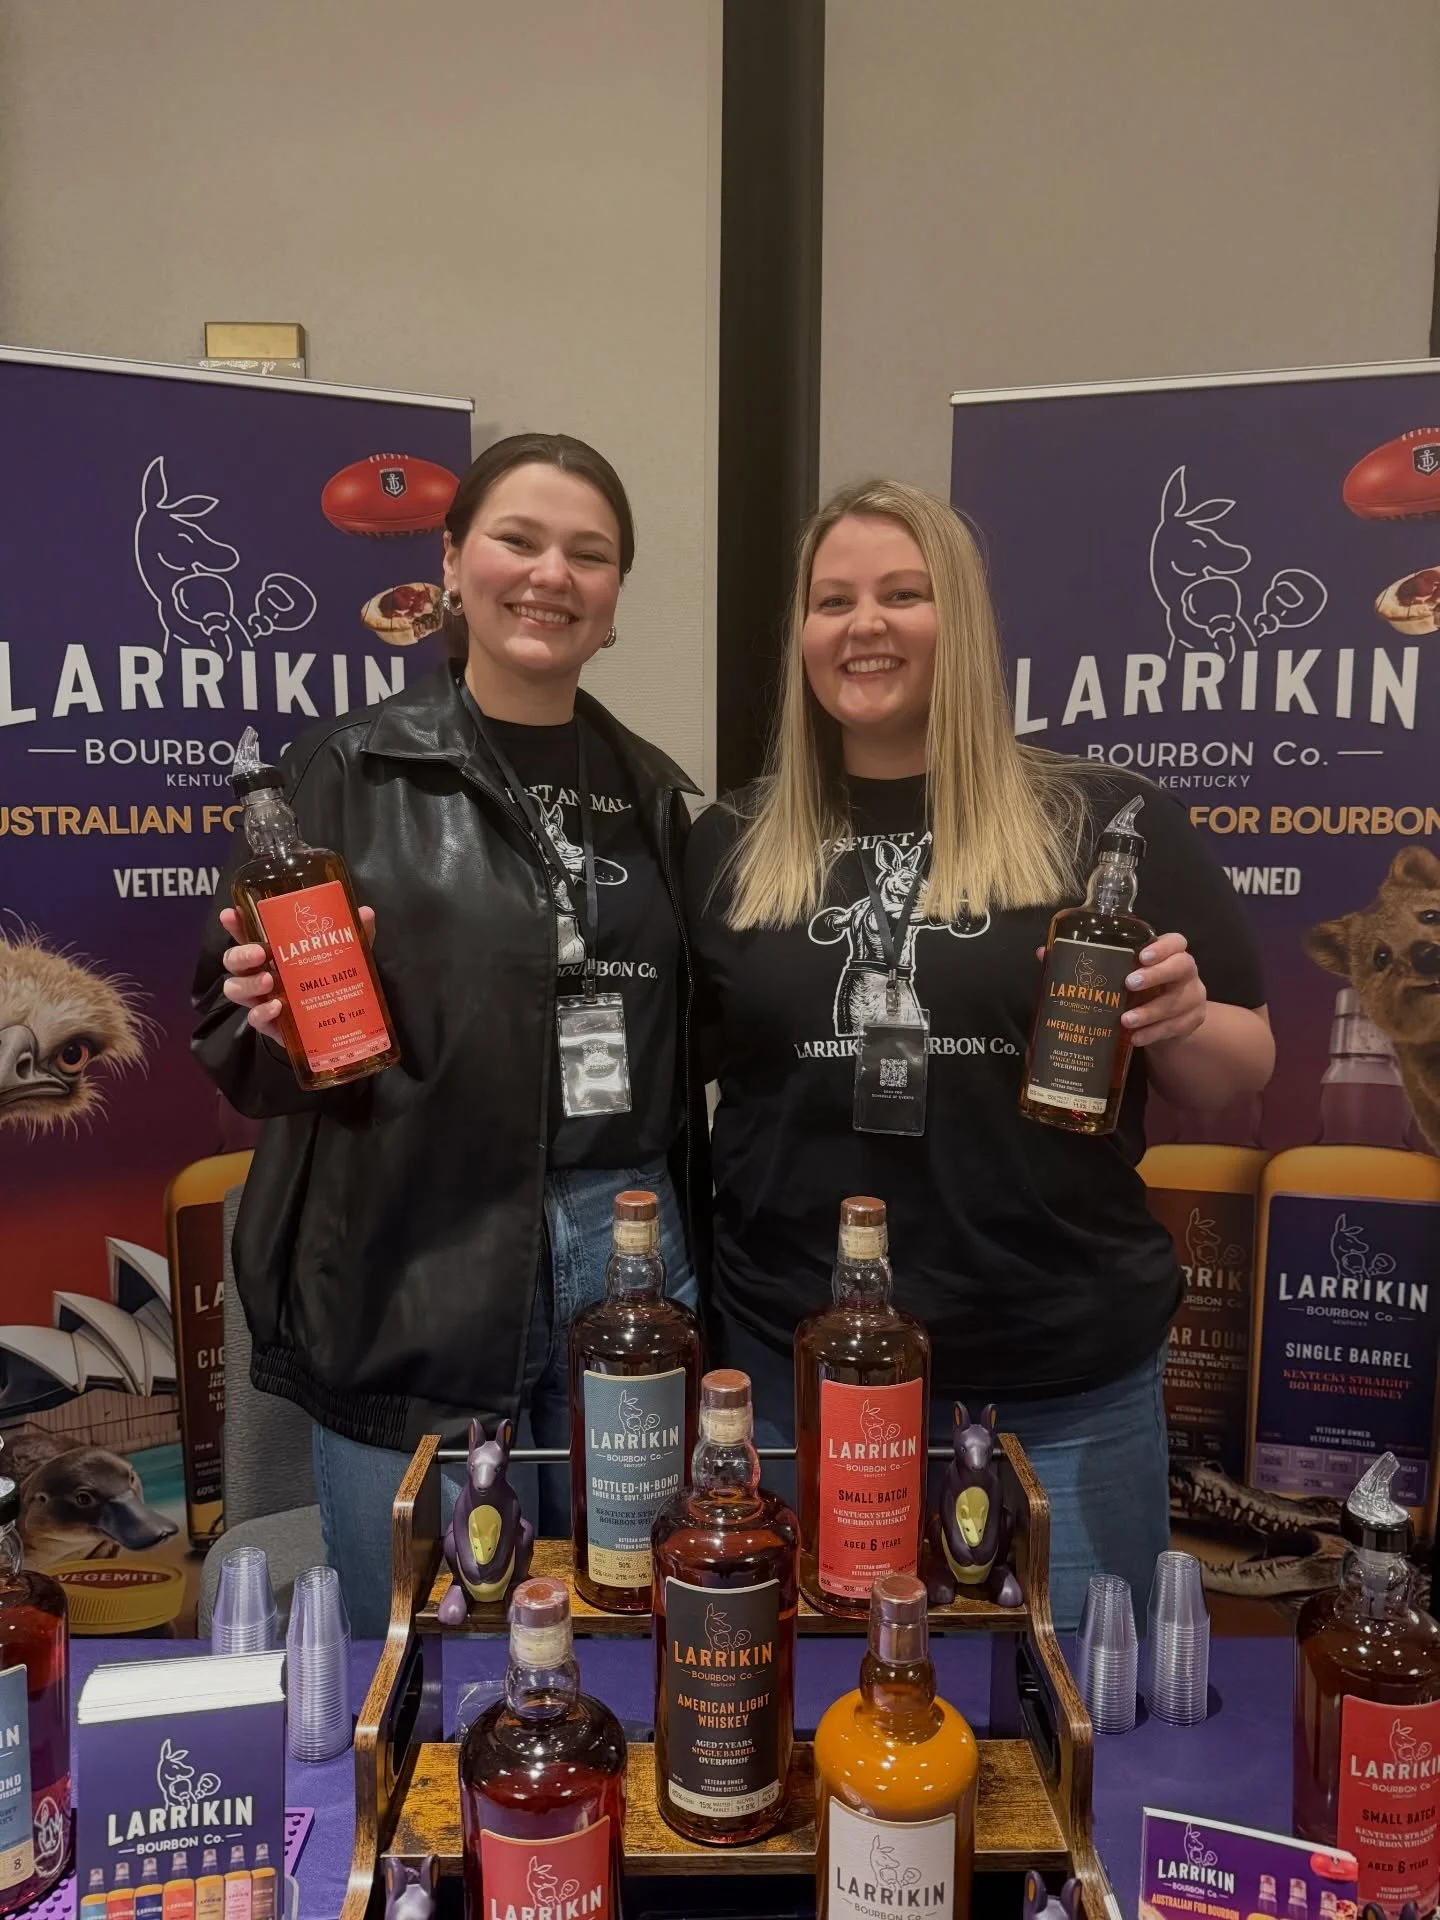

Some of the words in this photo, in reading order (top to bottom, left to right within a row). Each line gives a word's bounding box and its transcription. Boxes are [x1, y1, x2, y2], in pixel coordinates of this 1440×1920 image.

[0, 641, 406, 727] LARRIKIN
[1014, 646, 1420, 737] LARRIKIN
[1088, 741, 1254, 767] BOURBON
[1274, 741, 1329, 767] Co.
[166, 774, 233, 787] KENTUC
[1158, 775, 1251, 788] KENTUCKY
[0, 806, 193, 835] STRALIAN
[202, 806, 245, 834] FO
[1222, 866, 1301, 896] WNED
[277, 926, 355, 963] LARRIKIN
[300, 976, 331, 992] SMALL
[332, 967, 358, 984] BATCH
[1050, 981, 1121, 1009] LARRIKIN
[318, 1017, 337, 1028] AGED
[338, 1012, 346, 1024] 6
[348, 1008, 366, 1019] YEARS
[1045, 1018, 1087, 1034] AMERICAN
[1088, 1024, 1113, 1038] LIGHT
[794, 1040, 860, 1058] LARRIK
[989, 1037, 1020, 1056] Co.
[1058, 1031, 1095, 1046] WHISKEY
[1279, 1272, 1429, 1312] LARRIKIN
[1306, 1305, 1370, 1321] BOURBON
[1285, 1342, 1343, 1362] SINGLE
[1349, 1347, 1412, 1369] BARREL
[1283, 1369, 1346, 1383] KENTUCKY
[1348, 1375, 1411, 1390] STRAIGHT
[1288, 1381, 1347, 1395] BOURBON
[1347, 1386, 1404, 1400] WHISKEY
[590, 1425, 680, 1450] LARRIKIN
[1316, 1426, 1346, 1436] VETERAN
[828, 1436, 917, 1460] LARRIKIN
[1309, 1435, 1340, 1445] VETERAN
[1341, 1438, 1376, 1449] DISTILLED
[606, 1453, 647, 1463] BOURBON
[846, 1463, 887, 1473] BOURBON
[591, 1474, 679, 1494] BOTTLED-IN-BOND
[643, 1486, 678, 1501] SUPERVISION
[838, 1489, 874, 1504] SMALL
[877, 1487, 908, 1503] BATCH
[595, 1507, 636, 1519] KENTUCKY
[833, 1507, 876, 1519] KENTUCKY
[876, 1505, 911, 1518] STRAIGHT
[837, 1516, 876, 1526] BOURBON
[876, 1514, 907, 1526] WHISKEY
[843, 1540, 866, 1550] AGED
[870, 1538, 878, 1551] 6
[881, 1538, 901, 1549] YEARS
[58, 1572, 165, 1582] VEGEMITE
[674, 1640, 773, 1667] LARRIKIN
[691, 1670, 736, 1682] BOURBON
[677, 1693, 735, 1714] AMERICAN
[739, 1692, 770, 1713] LIGHT
[698, 1714, 749, 1729] WHISKEY
[691, 1746, 723, 1757] SINGLE
[723, 1746, 757, 1757] BARREL
[695, 1739, 718, 1749] AGED
[724, 1738, 753, 1749] YEARS
[698, 1756, 750, 1766] OVERPROOF
[700, 1784, 723, 1792] VETERAN
[723, 1784, 748, 1792] DISTILLED
[1371, 1783, 1418, 1794] BOURBON
[107, 1796, 253, 1847] LARRIKIN
[1362, 1809, 1403, 1825] SMALL
[1407, 1806, 1437, 1824] BATCH
[1354, 1826, 1402, 1840] KENTUCKY
[136, 1835, 199, 1855] BOURBON
[203, 1833, 224, 1845] Co.
[1359, 1836, 1403, 1849] BOURBON
[14, 1858, 22, 1871] 8
[1367, 1861, 1394, 1872] AGED
[1398, 1860, 1406, 1874] 6
[1157, 1858, 1235, 1895] LARRIKIN
[836, 1866, 945, 1907] LARRIKIN
[1172, 1882, 1205, 1895] BOURBON
[491, 1884, 602, 1920] LARRIKIN
[1152, 1893, 1193, 1911] AUSTRALIAN
[1193, 1901, 1207, 1914] FOR
